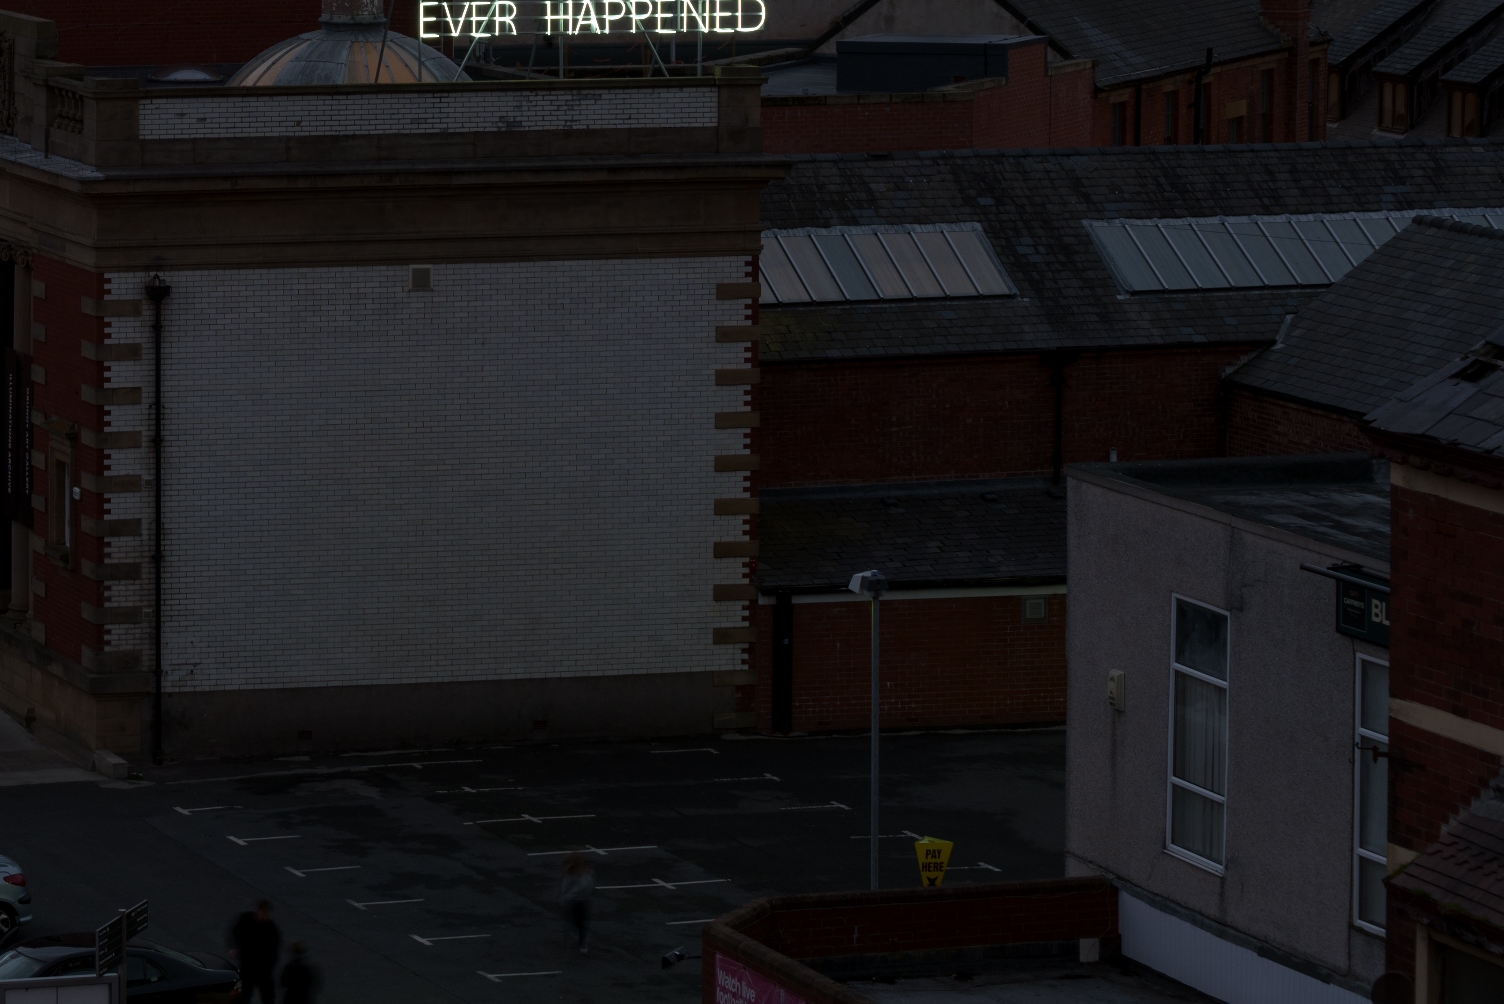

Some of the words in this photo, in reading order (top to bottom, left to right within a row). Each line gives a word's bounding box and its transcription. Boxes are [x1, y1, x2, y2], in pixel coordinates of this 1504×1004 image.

[419, 0, 517, 38] EVER
[925, 849, 942, 859] PAY
[922, 862, 944, 872] HERE
[717, 969, 741, 995] Watch
[741, 981, 756, 1003] live
